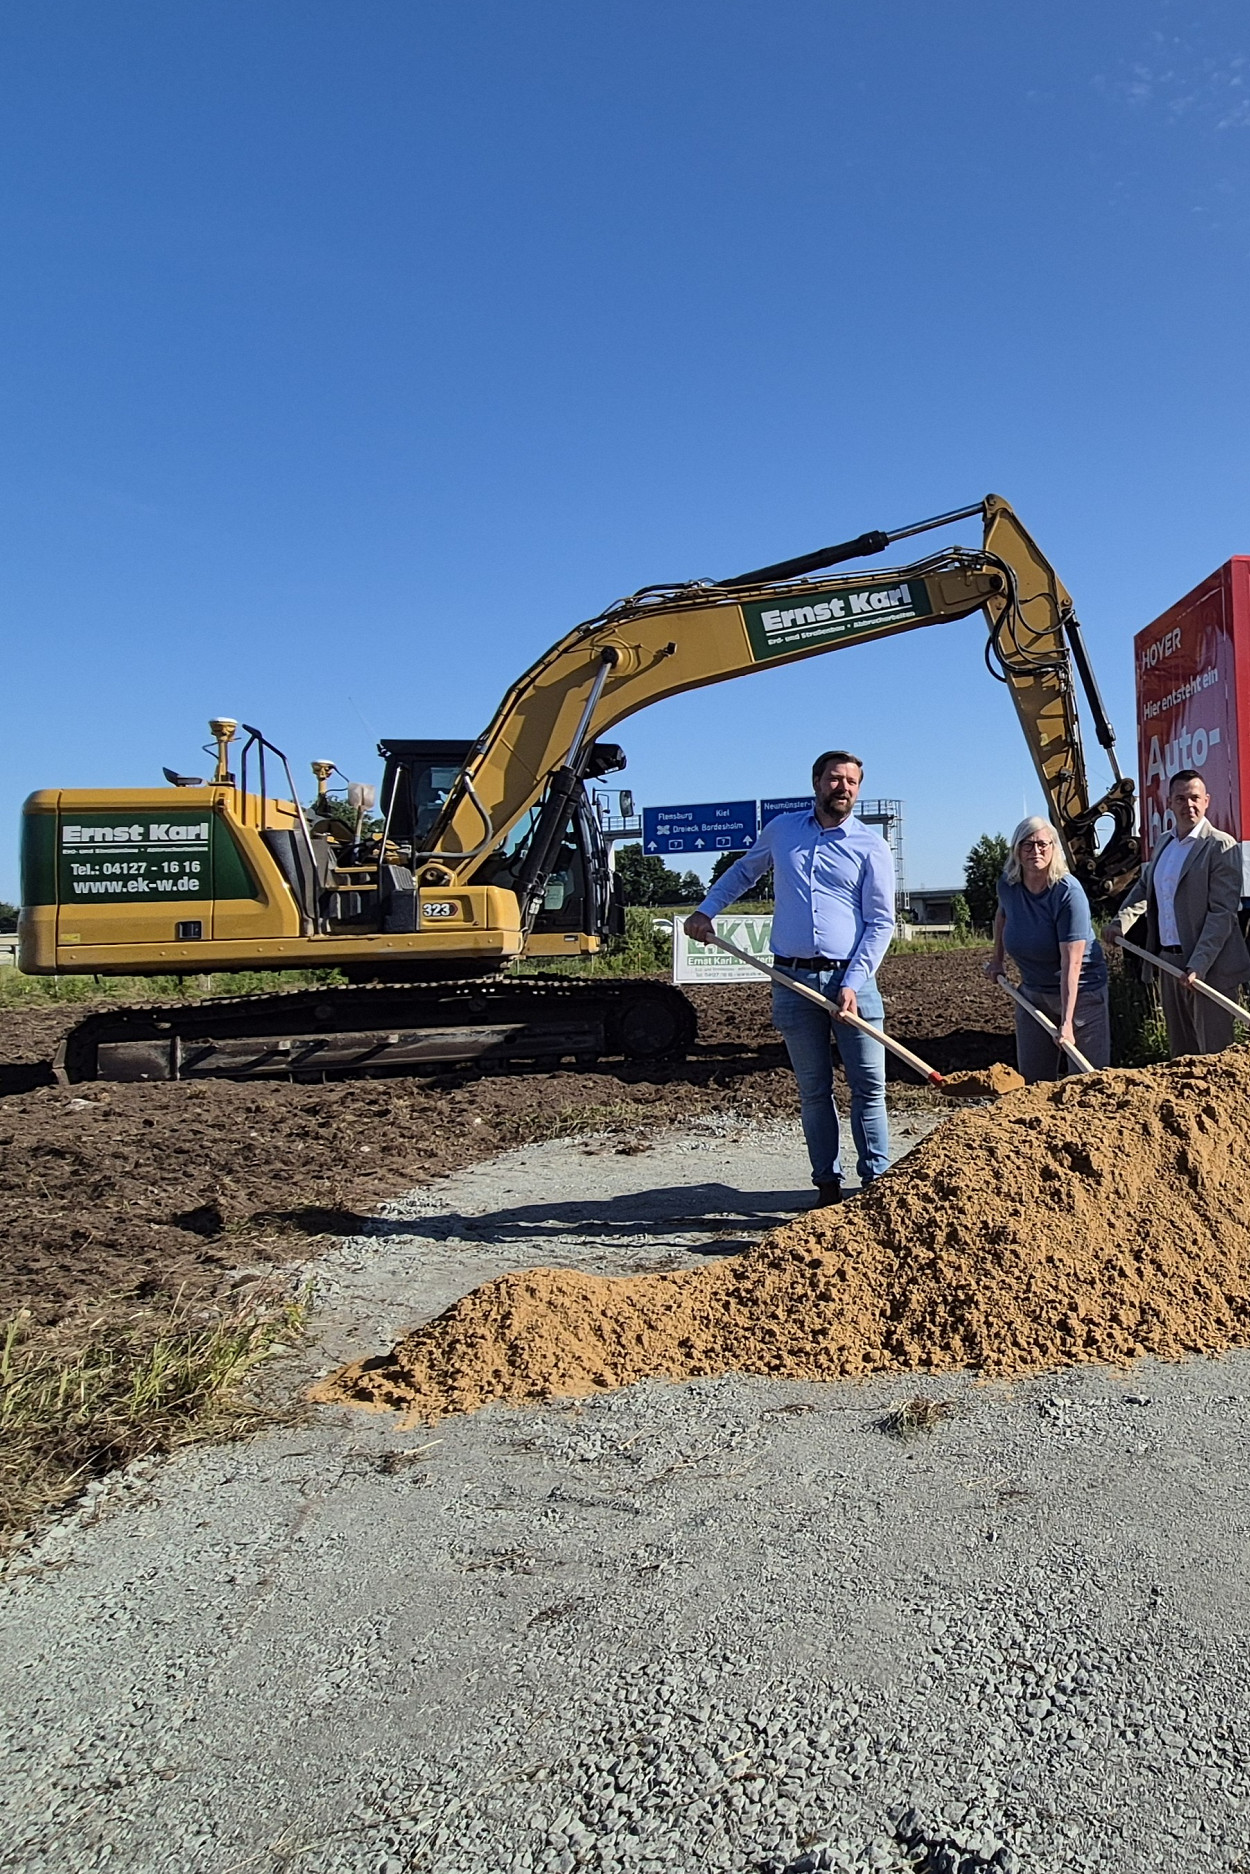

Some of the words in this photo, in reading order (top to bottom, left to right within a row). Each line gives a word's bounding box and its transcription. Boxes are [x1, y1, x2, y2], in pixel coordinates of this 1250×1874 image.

[760, 598, 846, 631] Ernst
[849, 584, 912, 614] Karl
[1142, 627, 1181, 672] HOYER
[1144, 700, 1161, 720] Hier
[1162, 675, 1202, 710] entsteht
[1202, 666, 1218, 688] ein
[1147, 725, 1221, 786] Auto-
[658, 812, 692, 820] Flensburg
[716, 809, 730, 817] Kiel
[1148, 797, 1177, 848] ho
[62, 824, 144, 842] Ernst
[150, 823, 208, 840] Karl
[702, 822, 744, 832] Bordesholm
[71, 864, 100, 875] Tel.:
[103, 862, 147, 874] 04127
[161, 861, 179, 872] 16
[183, 860, 200, 872] 16
[73, 876, 200, 894] www.ek-w.de
[424, 904, 450, 916] 323
[688, 957, 712, 965] Ernst
[714, 956, 732, 964] Karl
